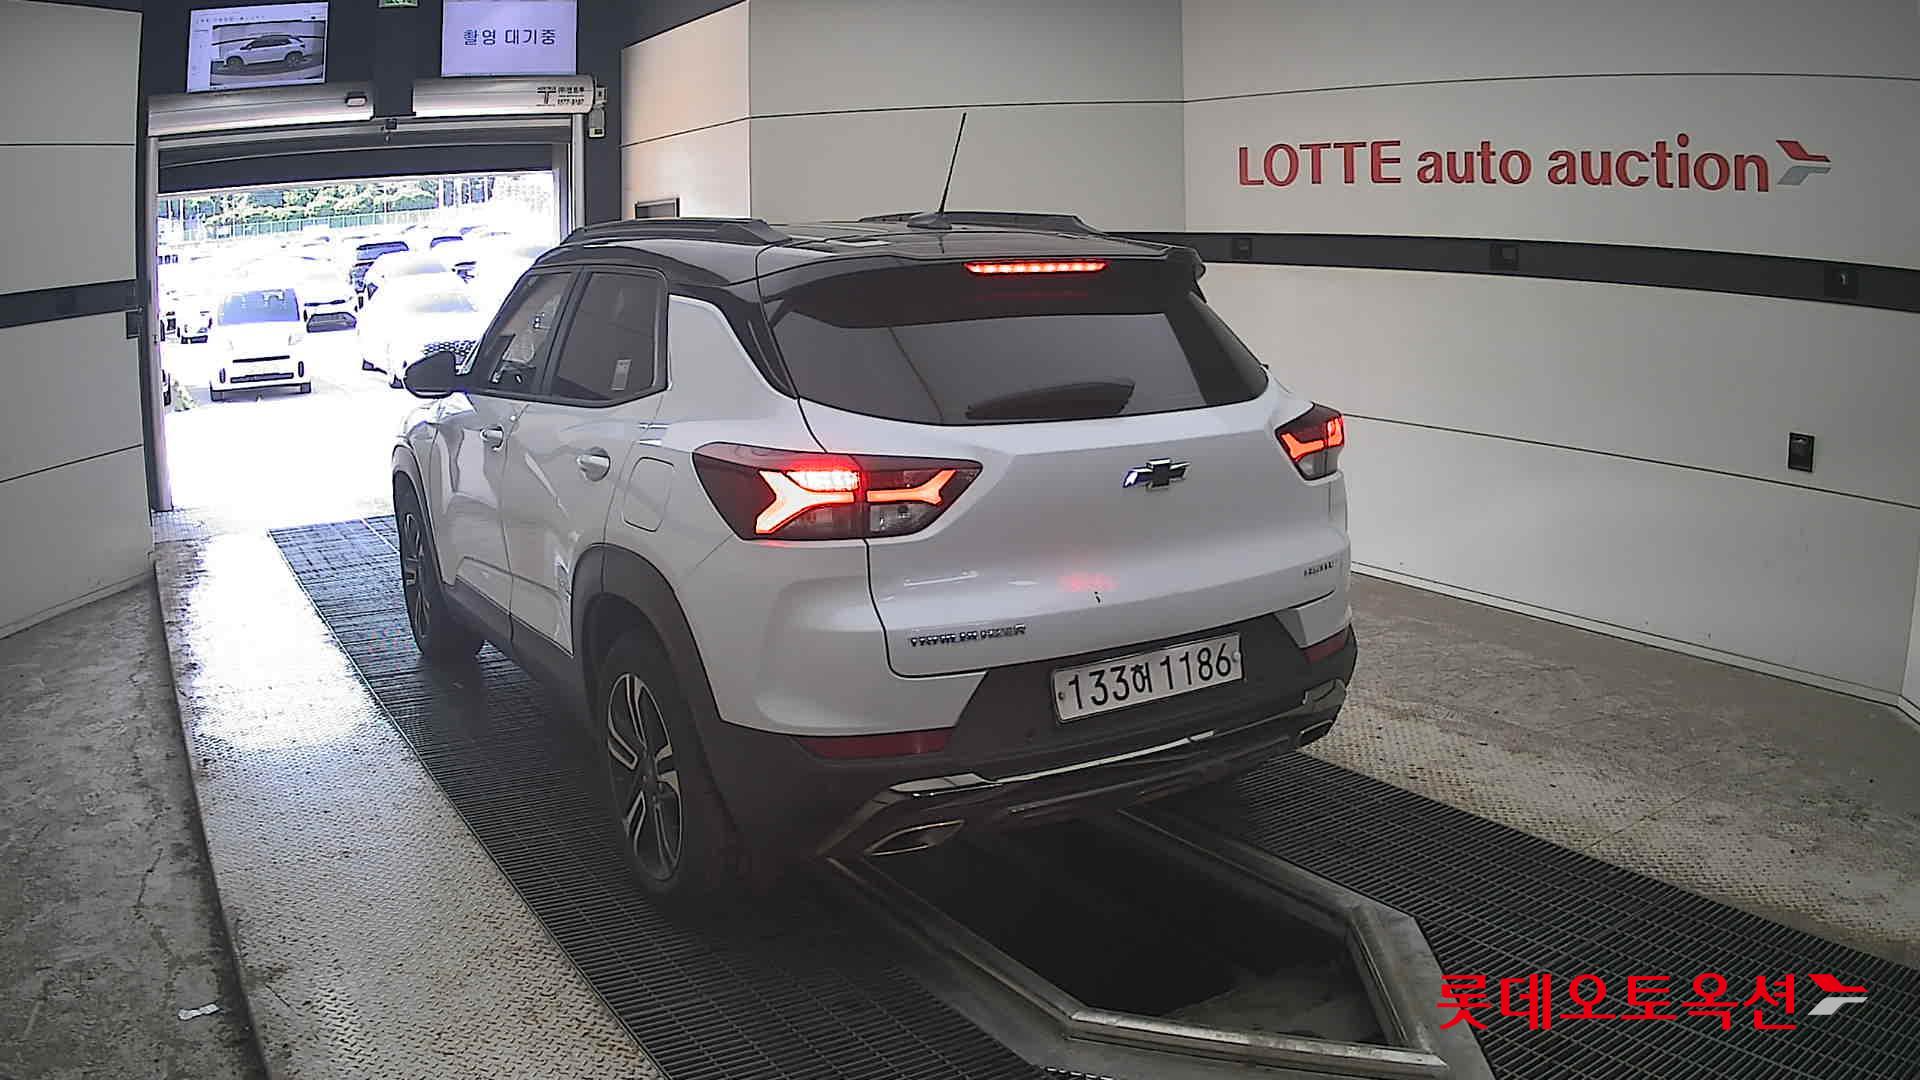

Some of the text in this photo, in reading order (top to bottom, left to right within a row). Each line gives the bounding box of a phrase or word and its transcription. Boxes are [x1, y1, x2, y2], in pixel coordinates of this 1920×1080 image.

[504, 28, 557, 47] 대기중
[1237, 134, 1770, 192] LOTTE auto auction
